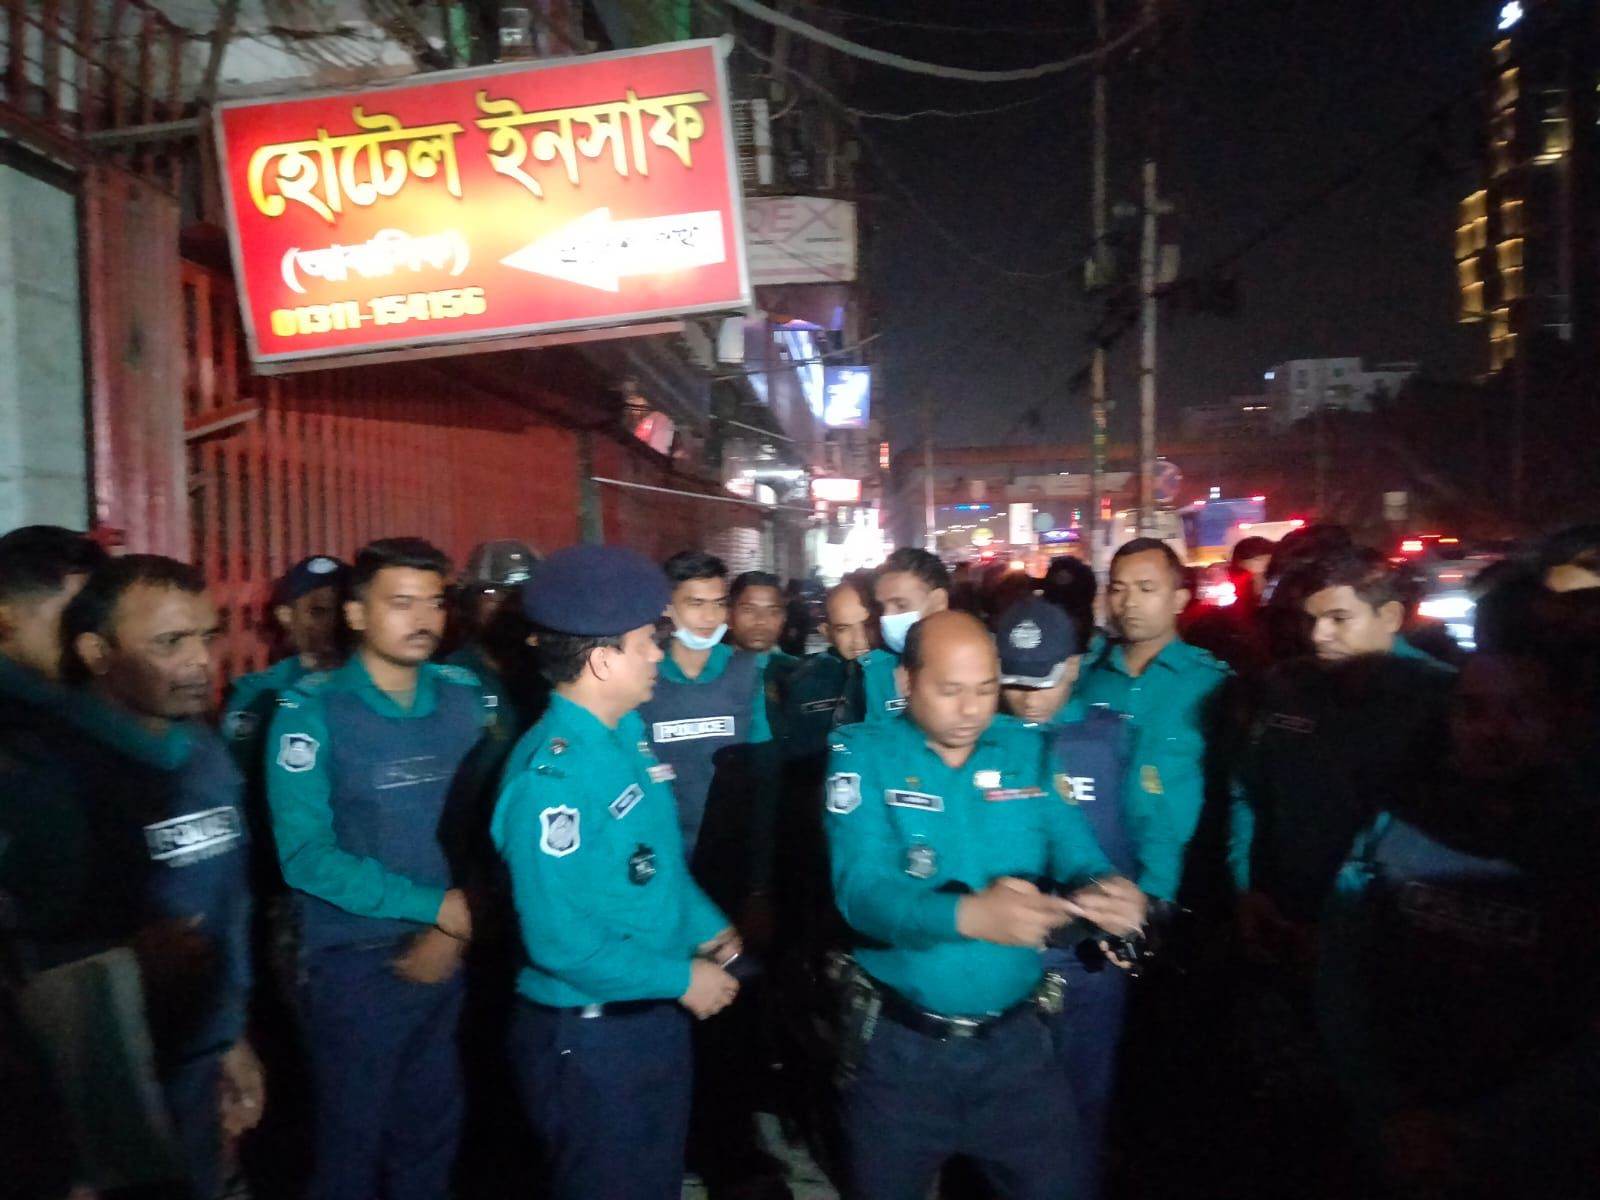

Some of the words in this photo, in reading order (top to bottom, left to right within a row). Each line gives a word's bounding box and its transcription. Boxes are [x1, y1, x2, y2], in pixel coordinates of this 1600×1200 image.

[247, 105, 466, 223] হোটেল
[475, 89, 712, 198] ইনসাফ
[659, 718, 728, 740] POLICE
